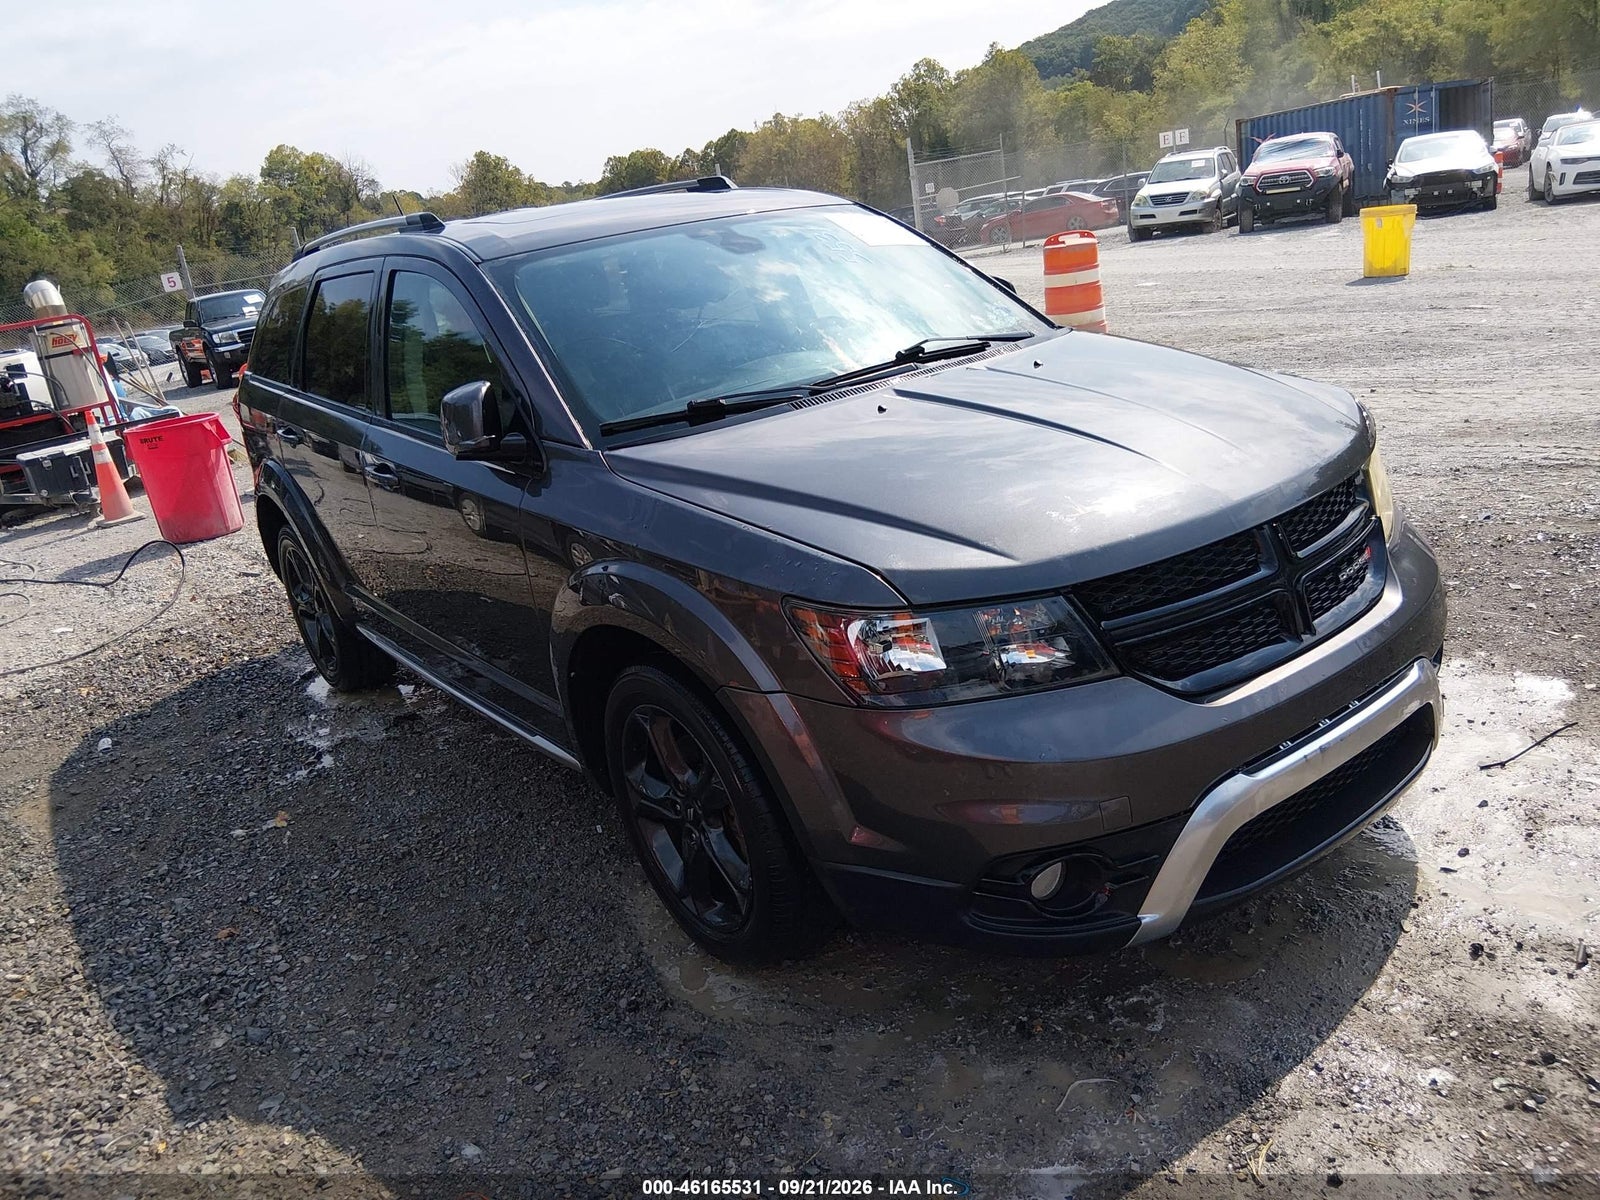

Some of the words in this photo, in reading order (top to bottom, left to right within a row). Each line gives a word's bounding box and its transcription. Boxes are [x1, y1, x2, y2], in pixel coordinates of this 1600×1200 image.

[1163, 134, 1170, 145] E
[1179, 131, 1186, 142] F
[166, 276, 177, 288] 5
